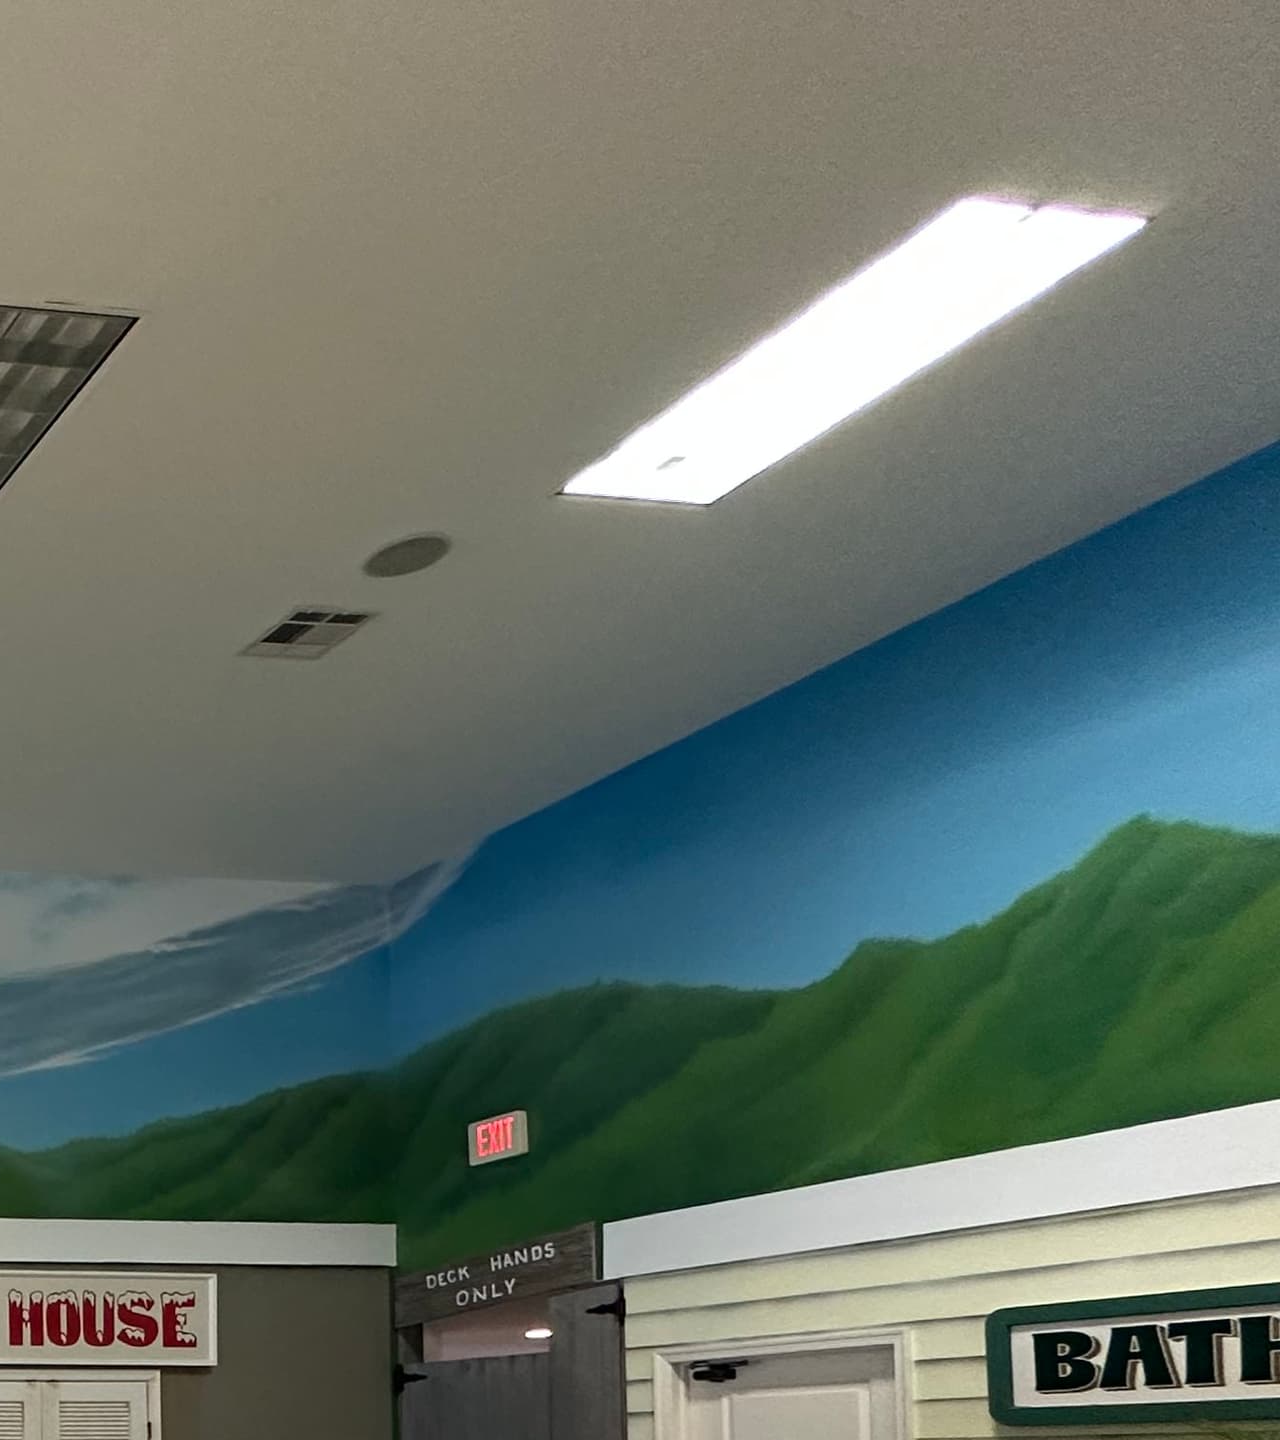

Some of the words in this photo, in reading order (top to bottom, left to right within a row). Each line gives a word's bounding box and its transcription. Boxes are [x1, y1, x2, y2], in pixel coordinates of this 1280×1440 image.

[476, 1116, 514, 1157] EXIT
[426, 1266, 471, 1289] DECK
[490, 1242, 556, 1272] HANDS
[455, 1278, 516, 1306] ONLY
[8, 1289, 197, 1347] HOUSE
